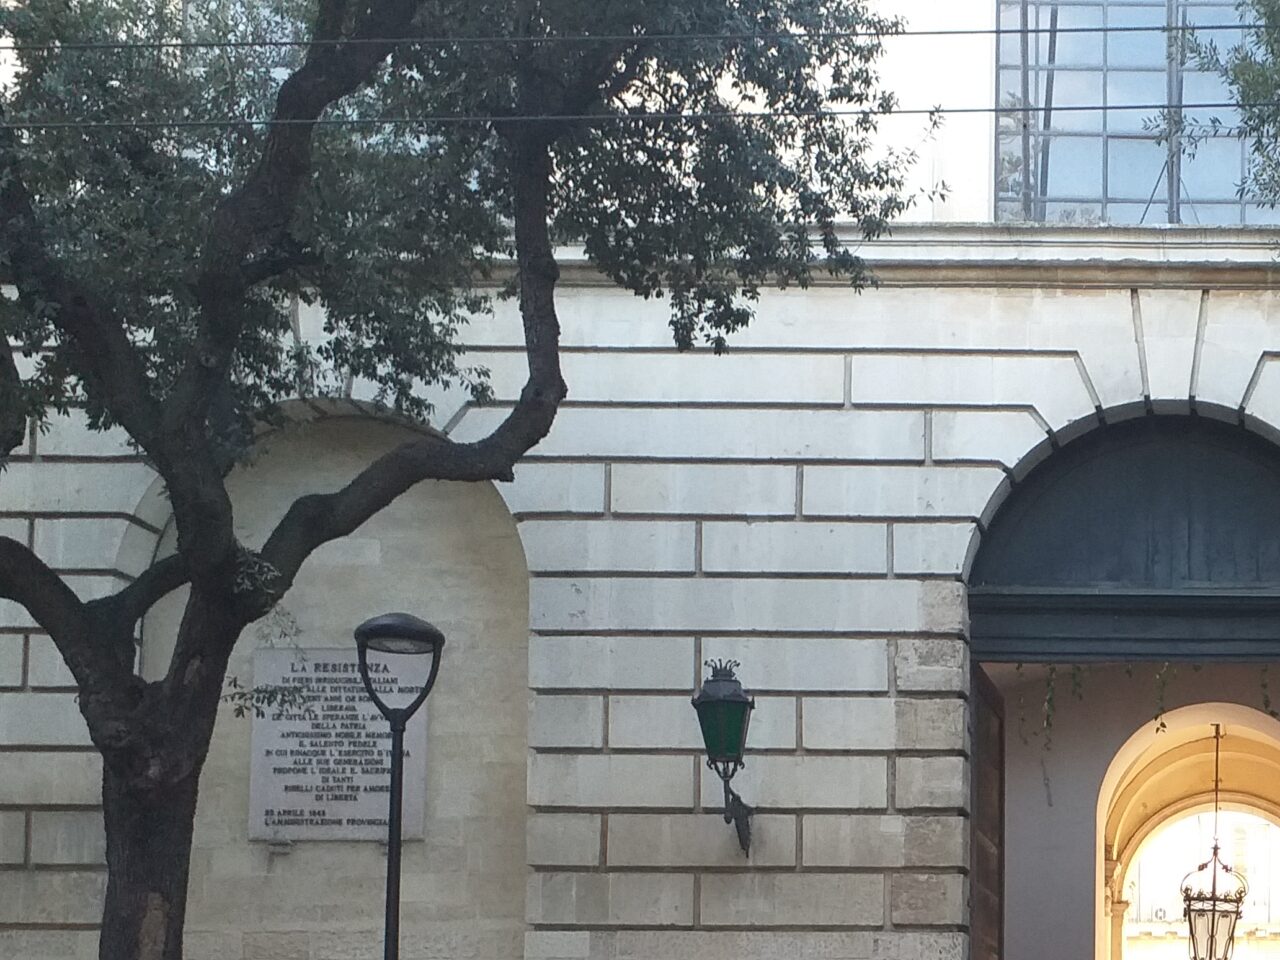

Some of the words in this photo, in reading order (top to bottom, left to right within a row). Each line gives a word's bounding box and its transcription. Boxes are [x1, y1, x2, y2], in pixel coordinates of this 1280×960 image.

[291, 662, 307, 673] LA
[314, 662, 390, 673] RESISTNZA
[311, 722, 337, 730] DELLA
[340, 722, 367, 730] PATRIA
[275, 749, 288, 757] CUI
[290, 749, 326, 757] RINACQUE
[293, 758, 313, 766] ALLE
[316, 758, 330, 766] SUE
[315, 793, 324, 801] DI
